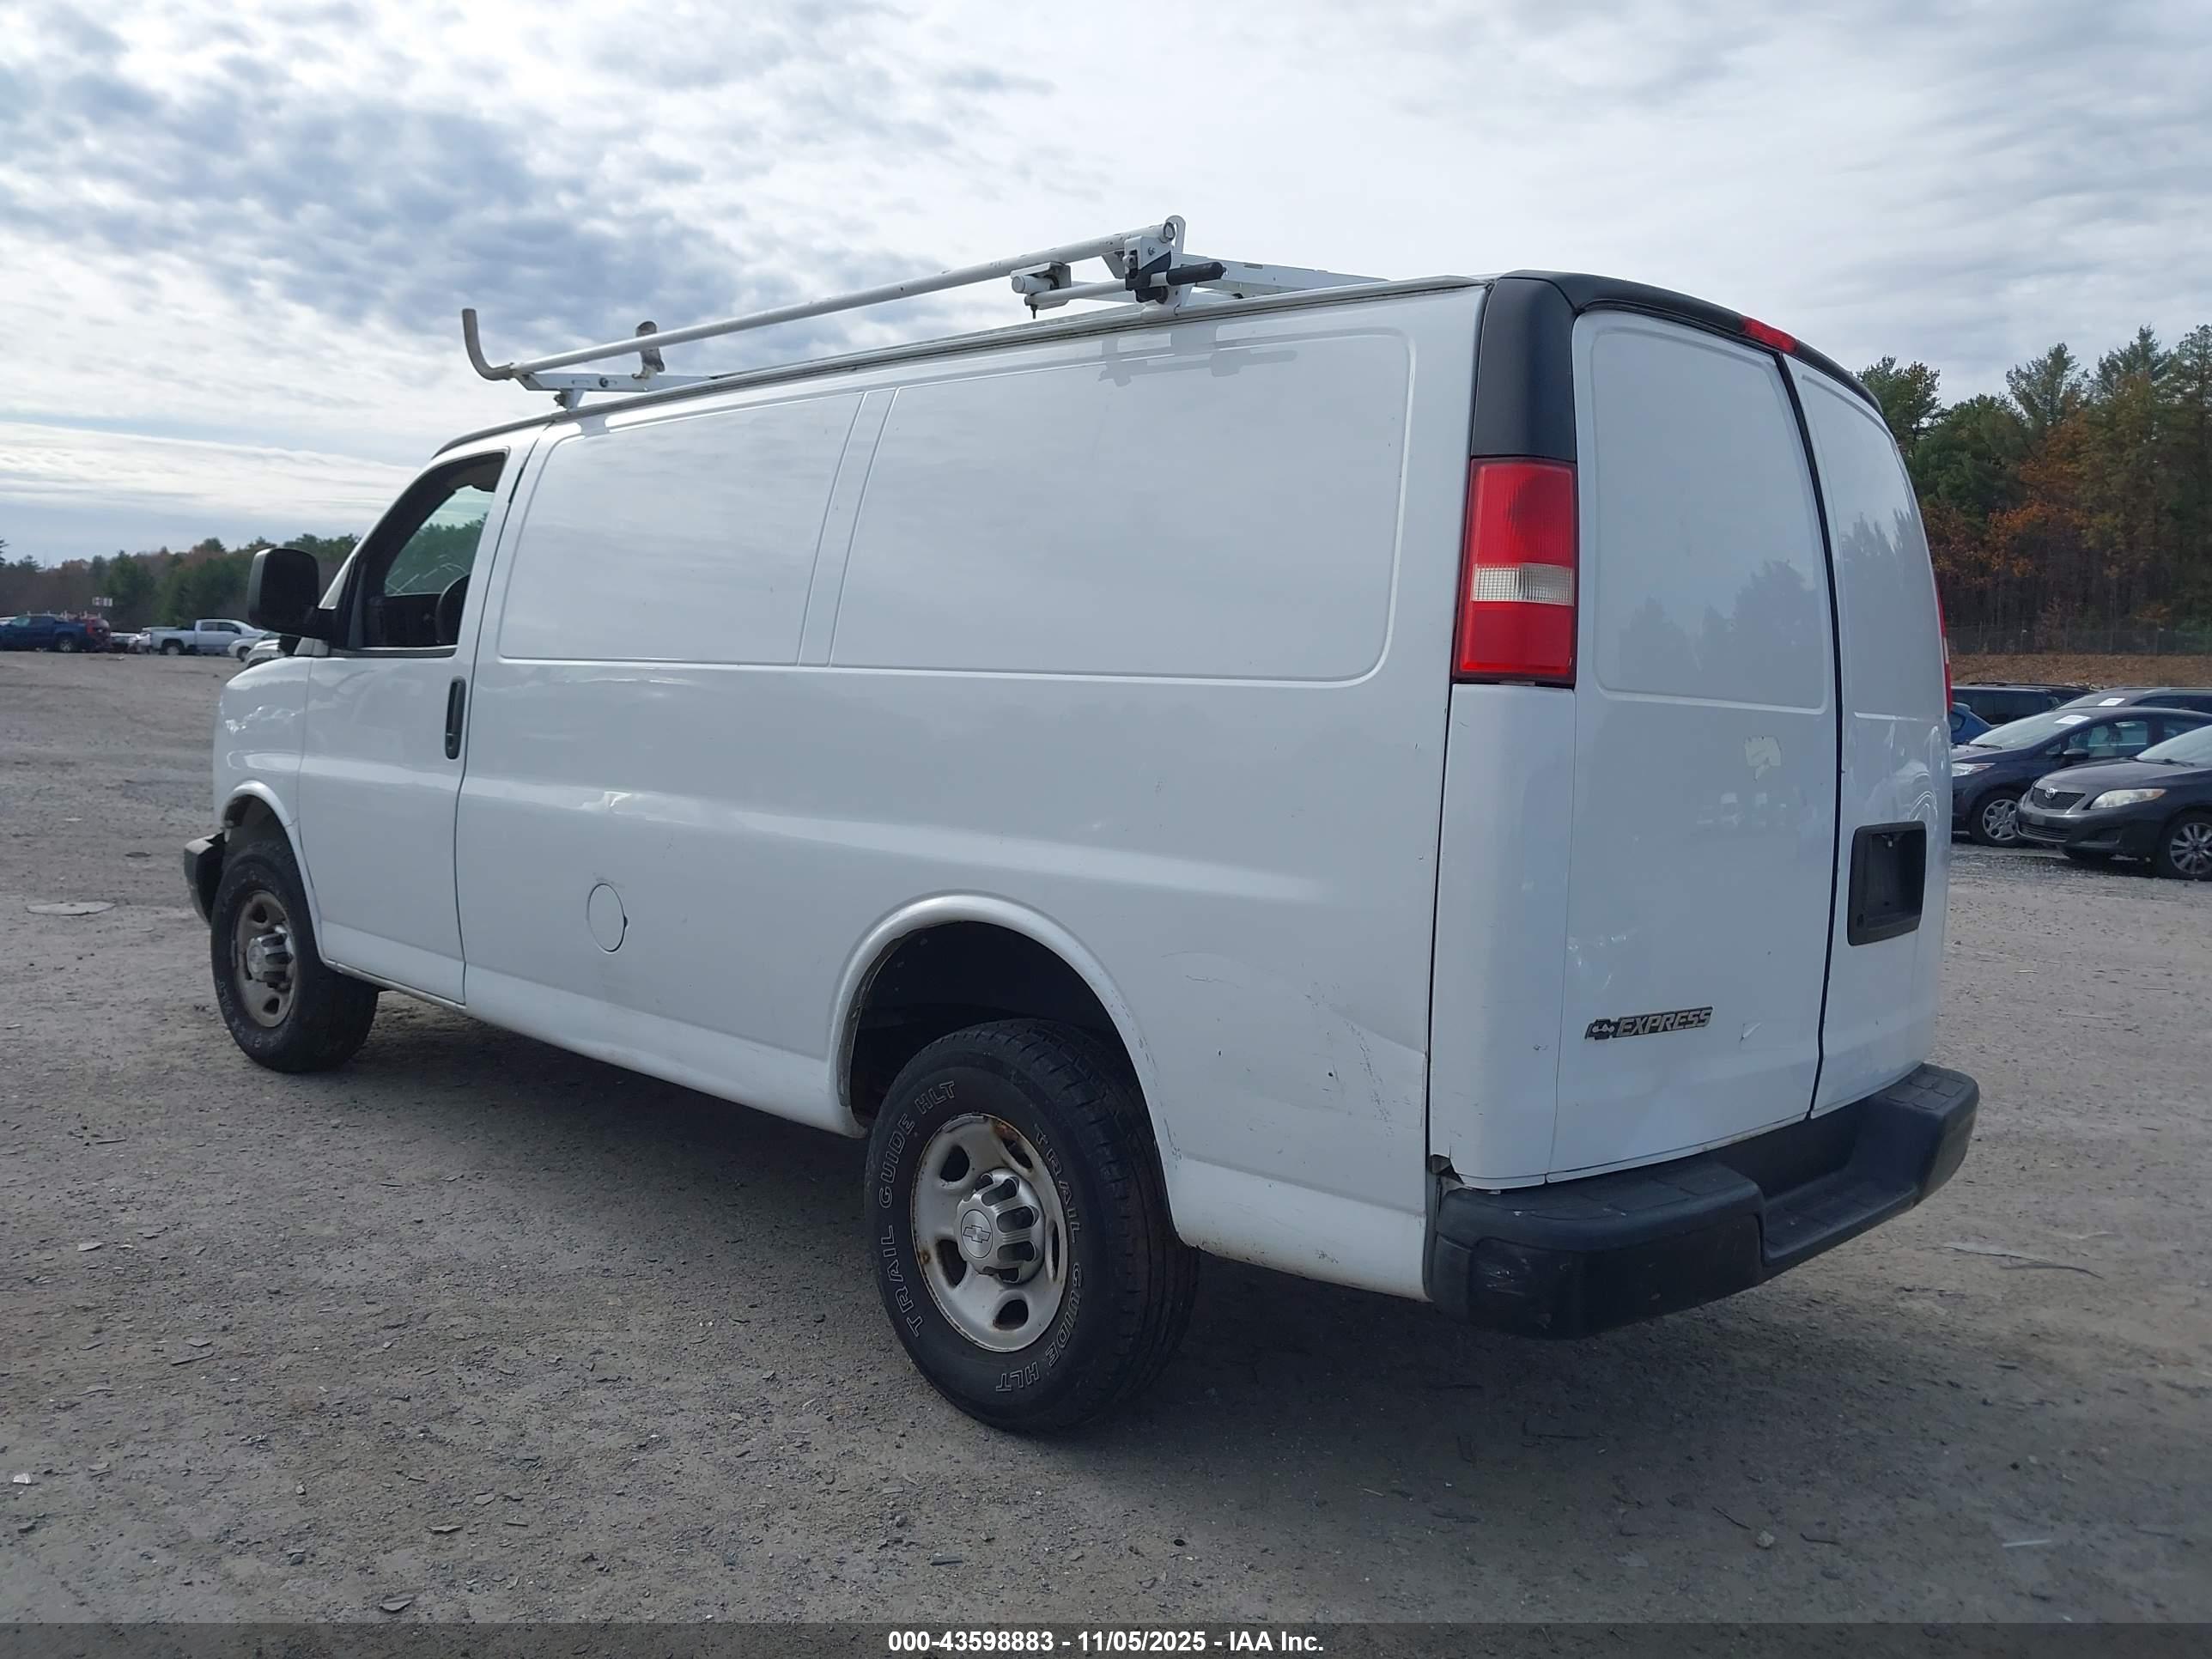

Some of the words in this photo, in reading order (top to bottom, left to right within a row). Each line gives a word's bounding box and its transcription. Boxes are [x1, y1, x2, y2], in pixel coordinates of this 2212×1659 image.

[1614, 1008, 1713, 1037] EXPRESS
[915, 1080, 955, 1115] HLT
[878, 1113, 915, 1209] GUIDE
[1034, 1123, 1080, 1243] TRAIL
[880, 1224, 924, 1338] TRAIL
[1045, 1262, 1083, 1367] GUIDE
[995, 1361, 1040, 1392] HLT
